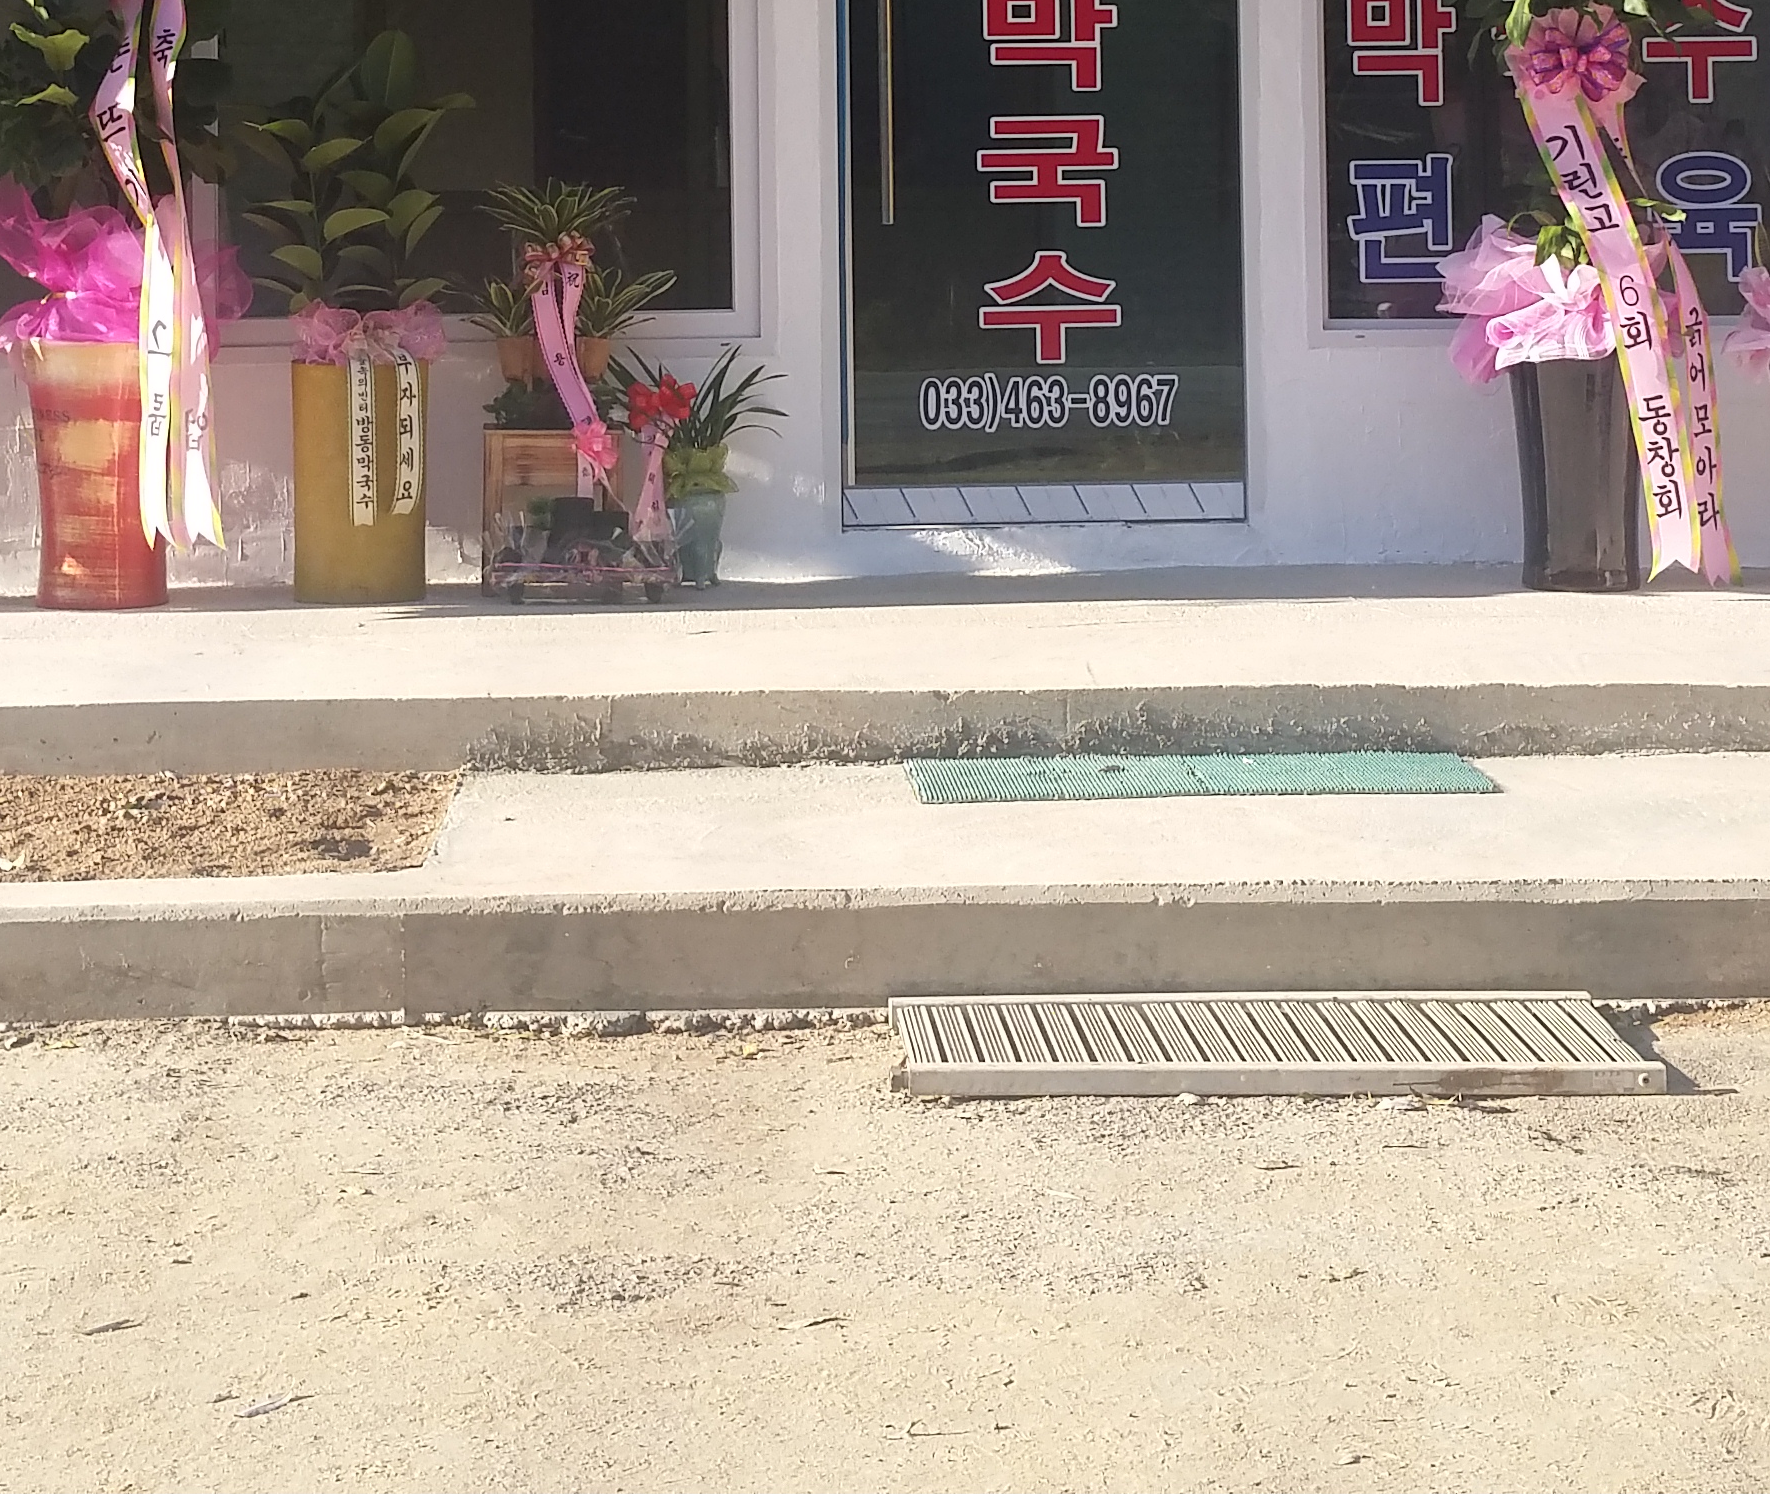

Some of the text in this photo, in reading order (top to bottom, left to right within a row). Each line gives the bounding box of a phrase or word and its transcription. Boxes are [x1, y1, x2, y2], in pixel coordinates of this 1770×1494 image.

[1545, 125, 1620, 235] 기린고
[1639, 395, 1684, 519] 동창회
[396, 354, 416, 501] 부자되세요
[918, 372, 1179, 434] 033)463-8967
